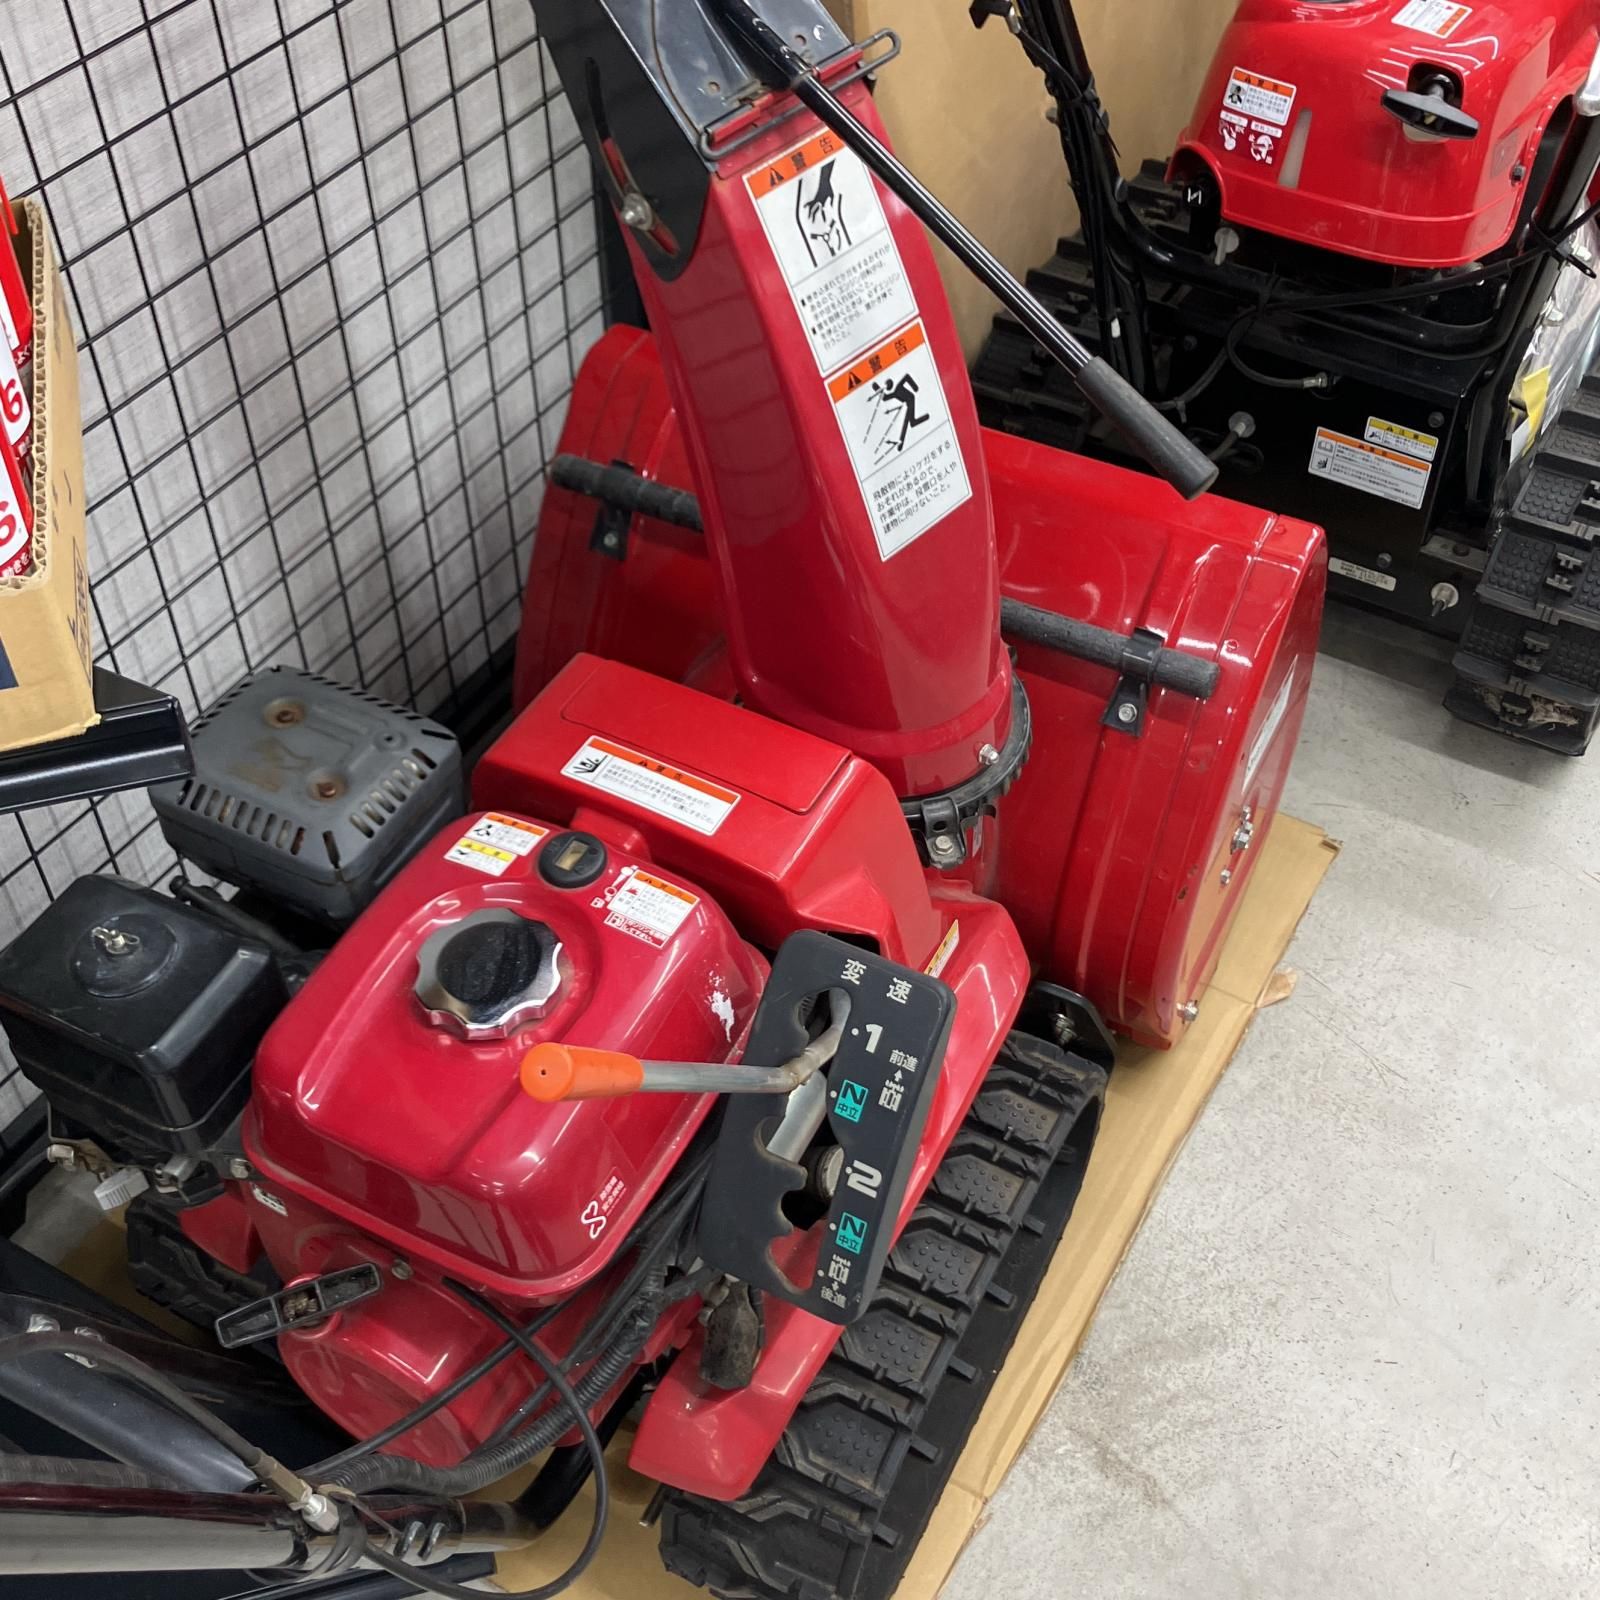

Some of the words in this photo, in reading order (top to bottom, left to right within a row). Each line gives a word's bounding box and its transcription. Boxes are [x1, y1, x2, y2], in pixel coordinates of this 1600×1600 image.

[868, 340, 907, 373] 警告
[872, 438, 951, 501] 飛散物によりケガをする
[875, 462, 937, 512] おそれがあるので、
[882, 478, 951, 534] 建物に向けないこと。
[865, 1023, 883, 1054] 1
[889, 1049, 919, 1073] 前進
[842, 1082, 868, 1105] N
[837, 1102, 858, 1119] 中立
[841, 1215, 865, 1239] N
[837, 1234, 858, 1250] 中立
[820, 1285, 847, 1309] 後進
